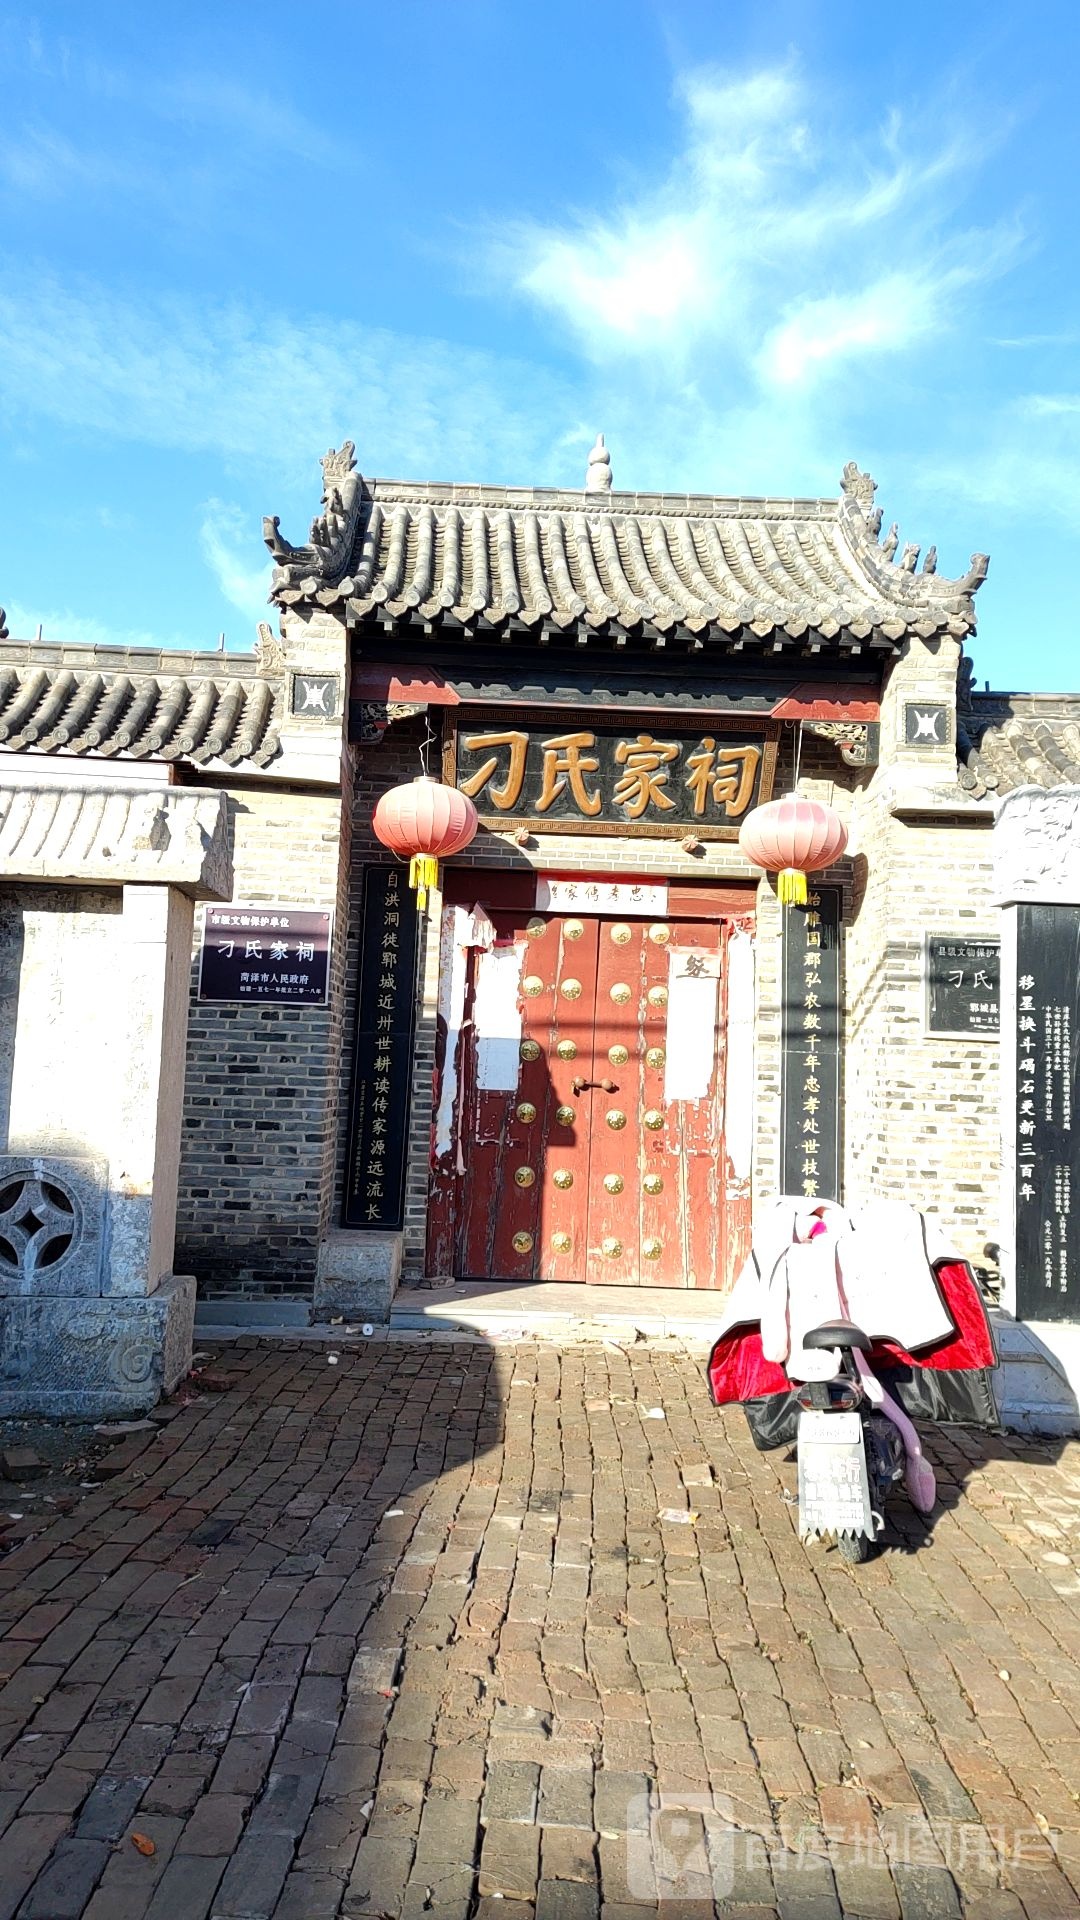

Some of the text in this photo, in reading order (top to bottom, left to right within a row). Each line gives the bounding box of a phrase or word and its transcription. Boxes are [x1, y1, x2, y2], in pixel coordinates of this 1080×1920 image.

[459, 731, 762, 819] 刁氏家祠
[211, 914, 290, 928] 市级文物保护单位
[217, 939, 315, 962] 刁氏家祠
[240, 972, 310, 985] 菏泽市人民政府
[947, 969, 994, 991] 刁氏
[969, 1002, 1001, 1014] 郓城县
